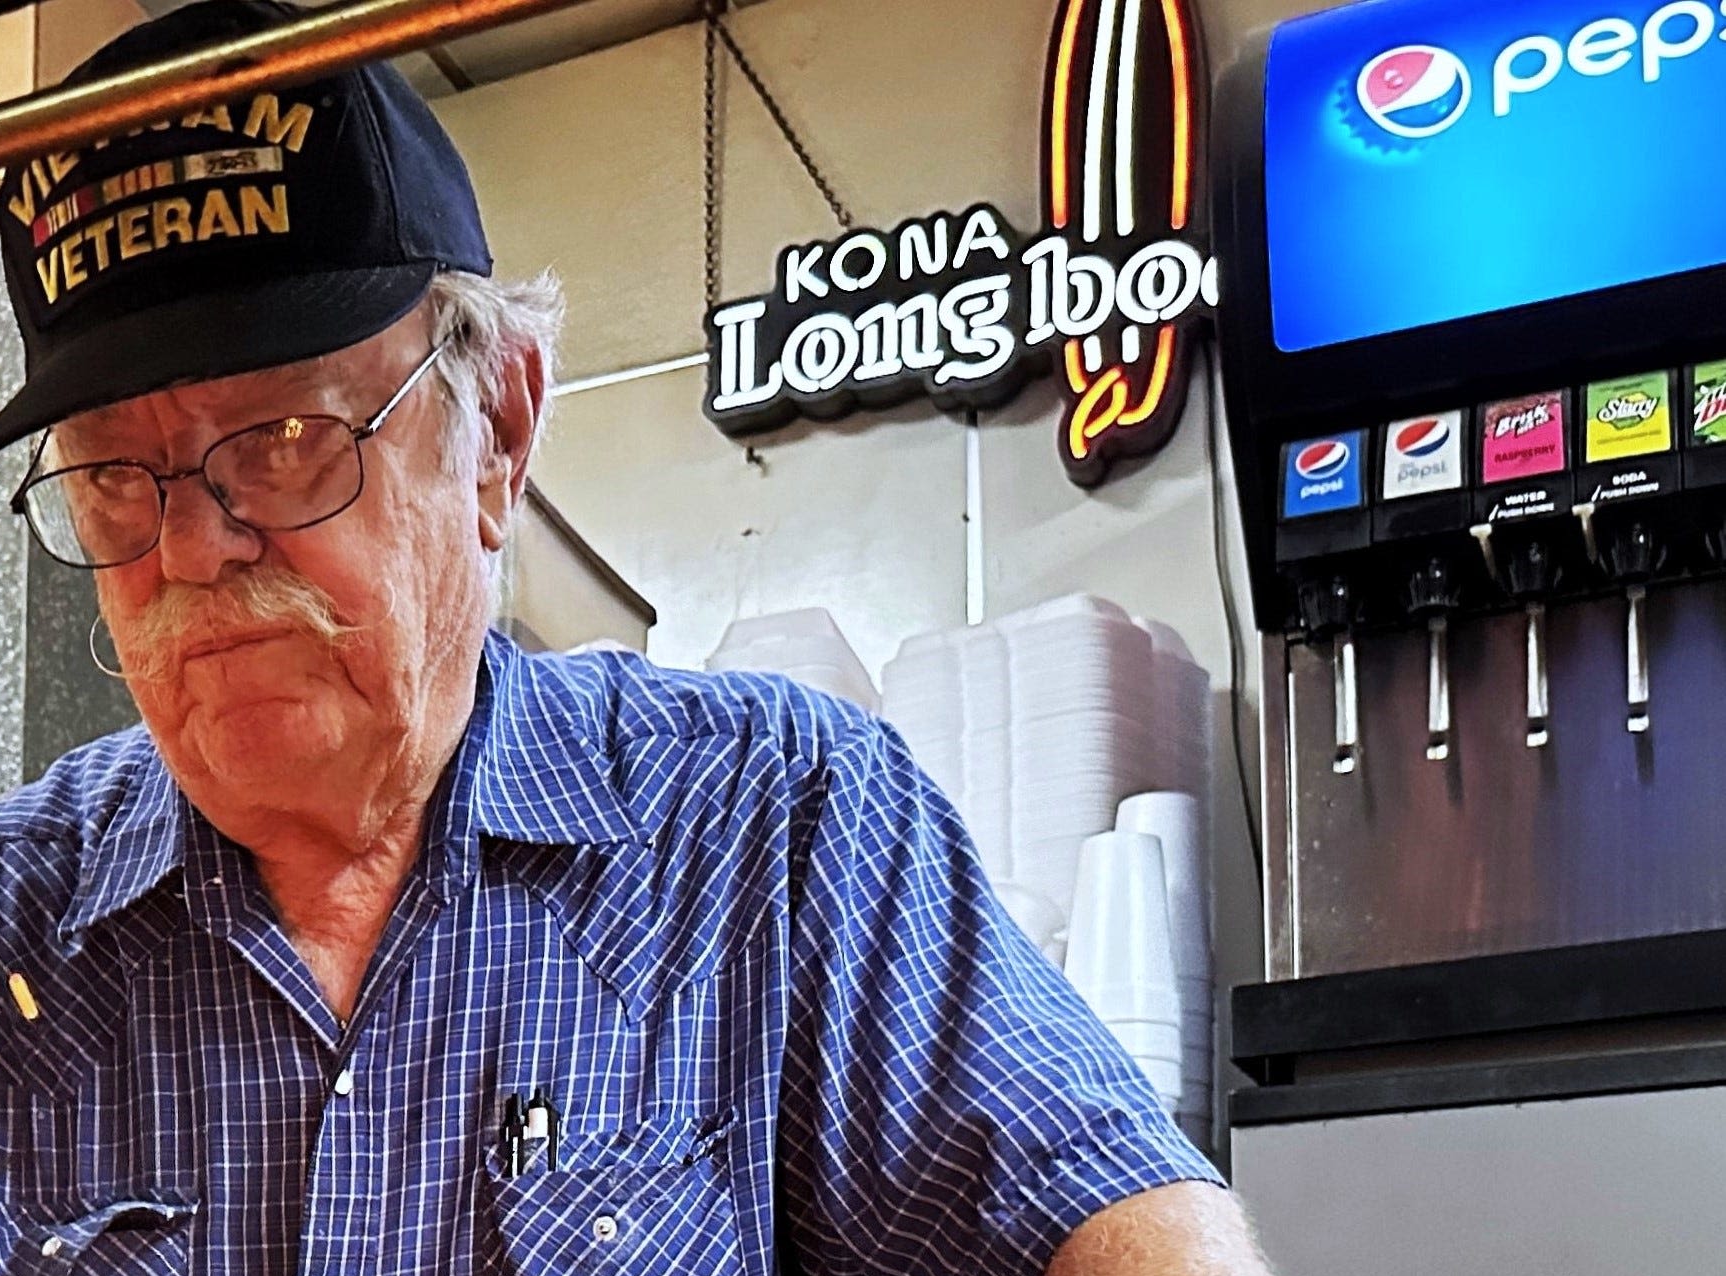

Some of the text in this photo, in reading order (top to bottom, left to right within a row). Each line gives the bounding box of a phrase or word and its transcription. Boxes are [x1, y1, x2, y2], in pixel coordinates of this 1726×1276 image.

[1493, 0, 1726, 117] pep
[9, 94, 313, 226] VIEAM
[36, 184, 290, 304] VETERAN
[786, 209, 1010, 303] KONA
[1495, 445, 1556, 462] RASPBERRY
[1398, 461, 1448, 482] pepsi
[1612, 471, 1647, 486] SODA
[1300, 477, 1343, 498] pepsi
[1505, 491, 1547, 505] WATER
